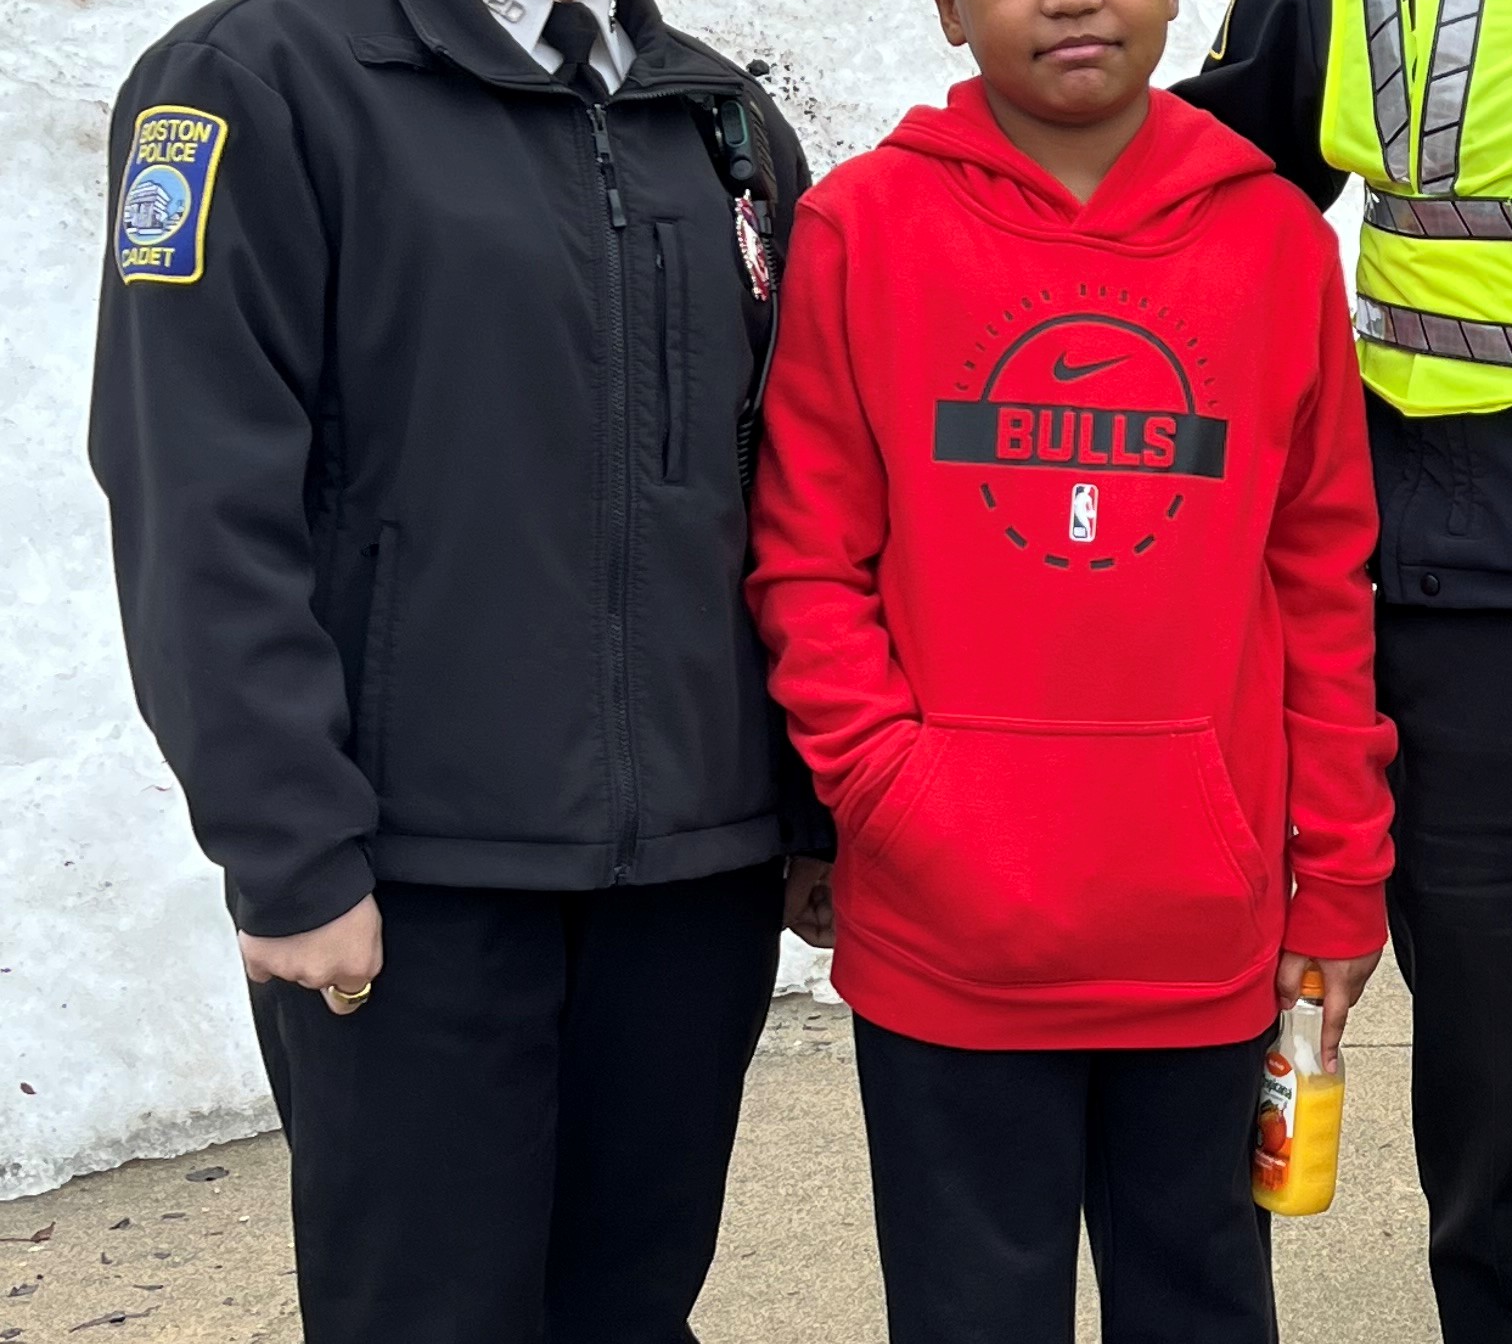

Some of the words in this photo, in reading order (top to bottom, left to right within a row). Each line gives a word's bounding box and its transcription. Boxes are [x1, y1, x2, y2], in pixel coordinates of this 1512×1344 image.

[139, 119, 213, 143] BOSTON
[135, 141, 198, 165] POLICE
[121, 247, 176, 269] CADET
[995, 406, 1177, 468] BULLS
